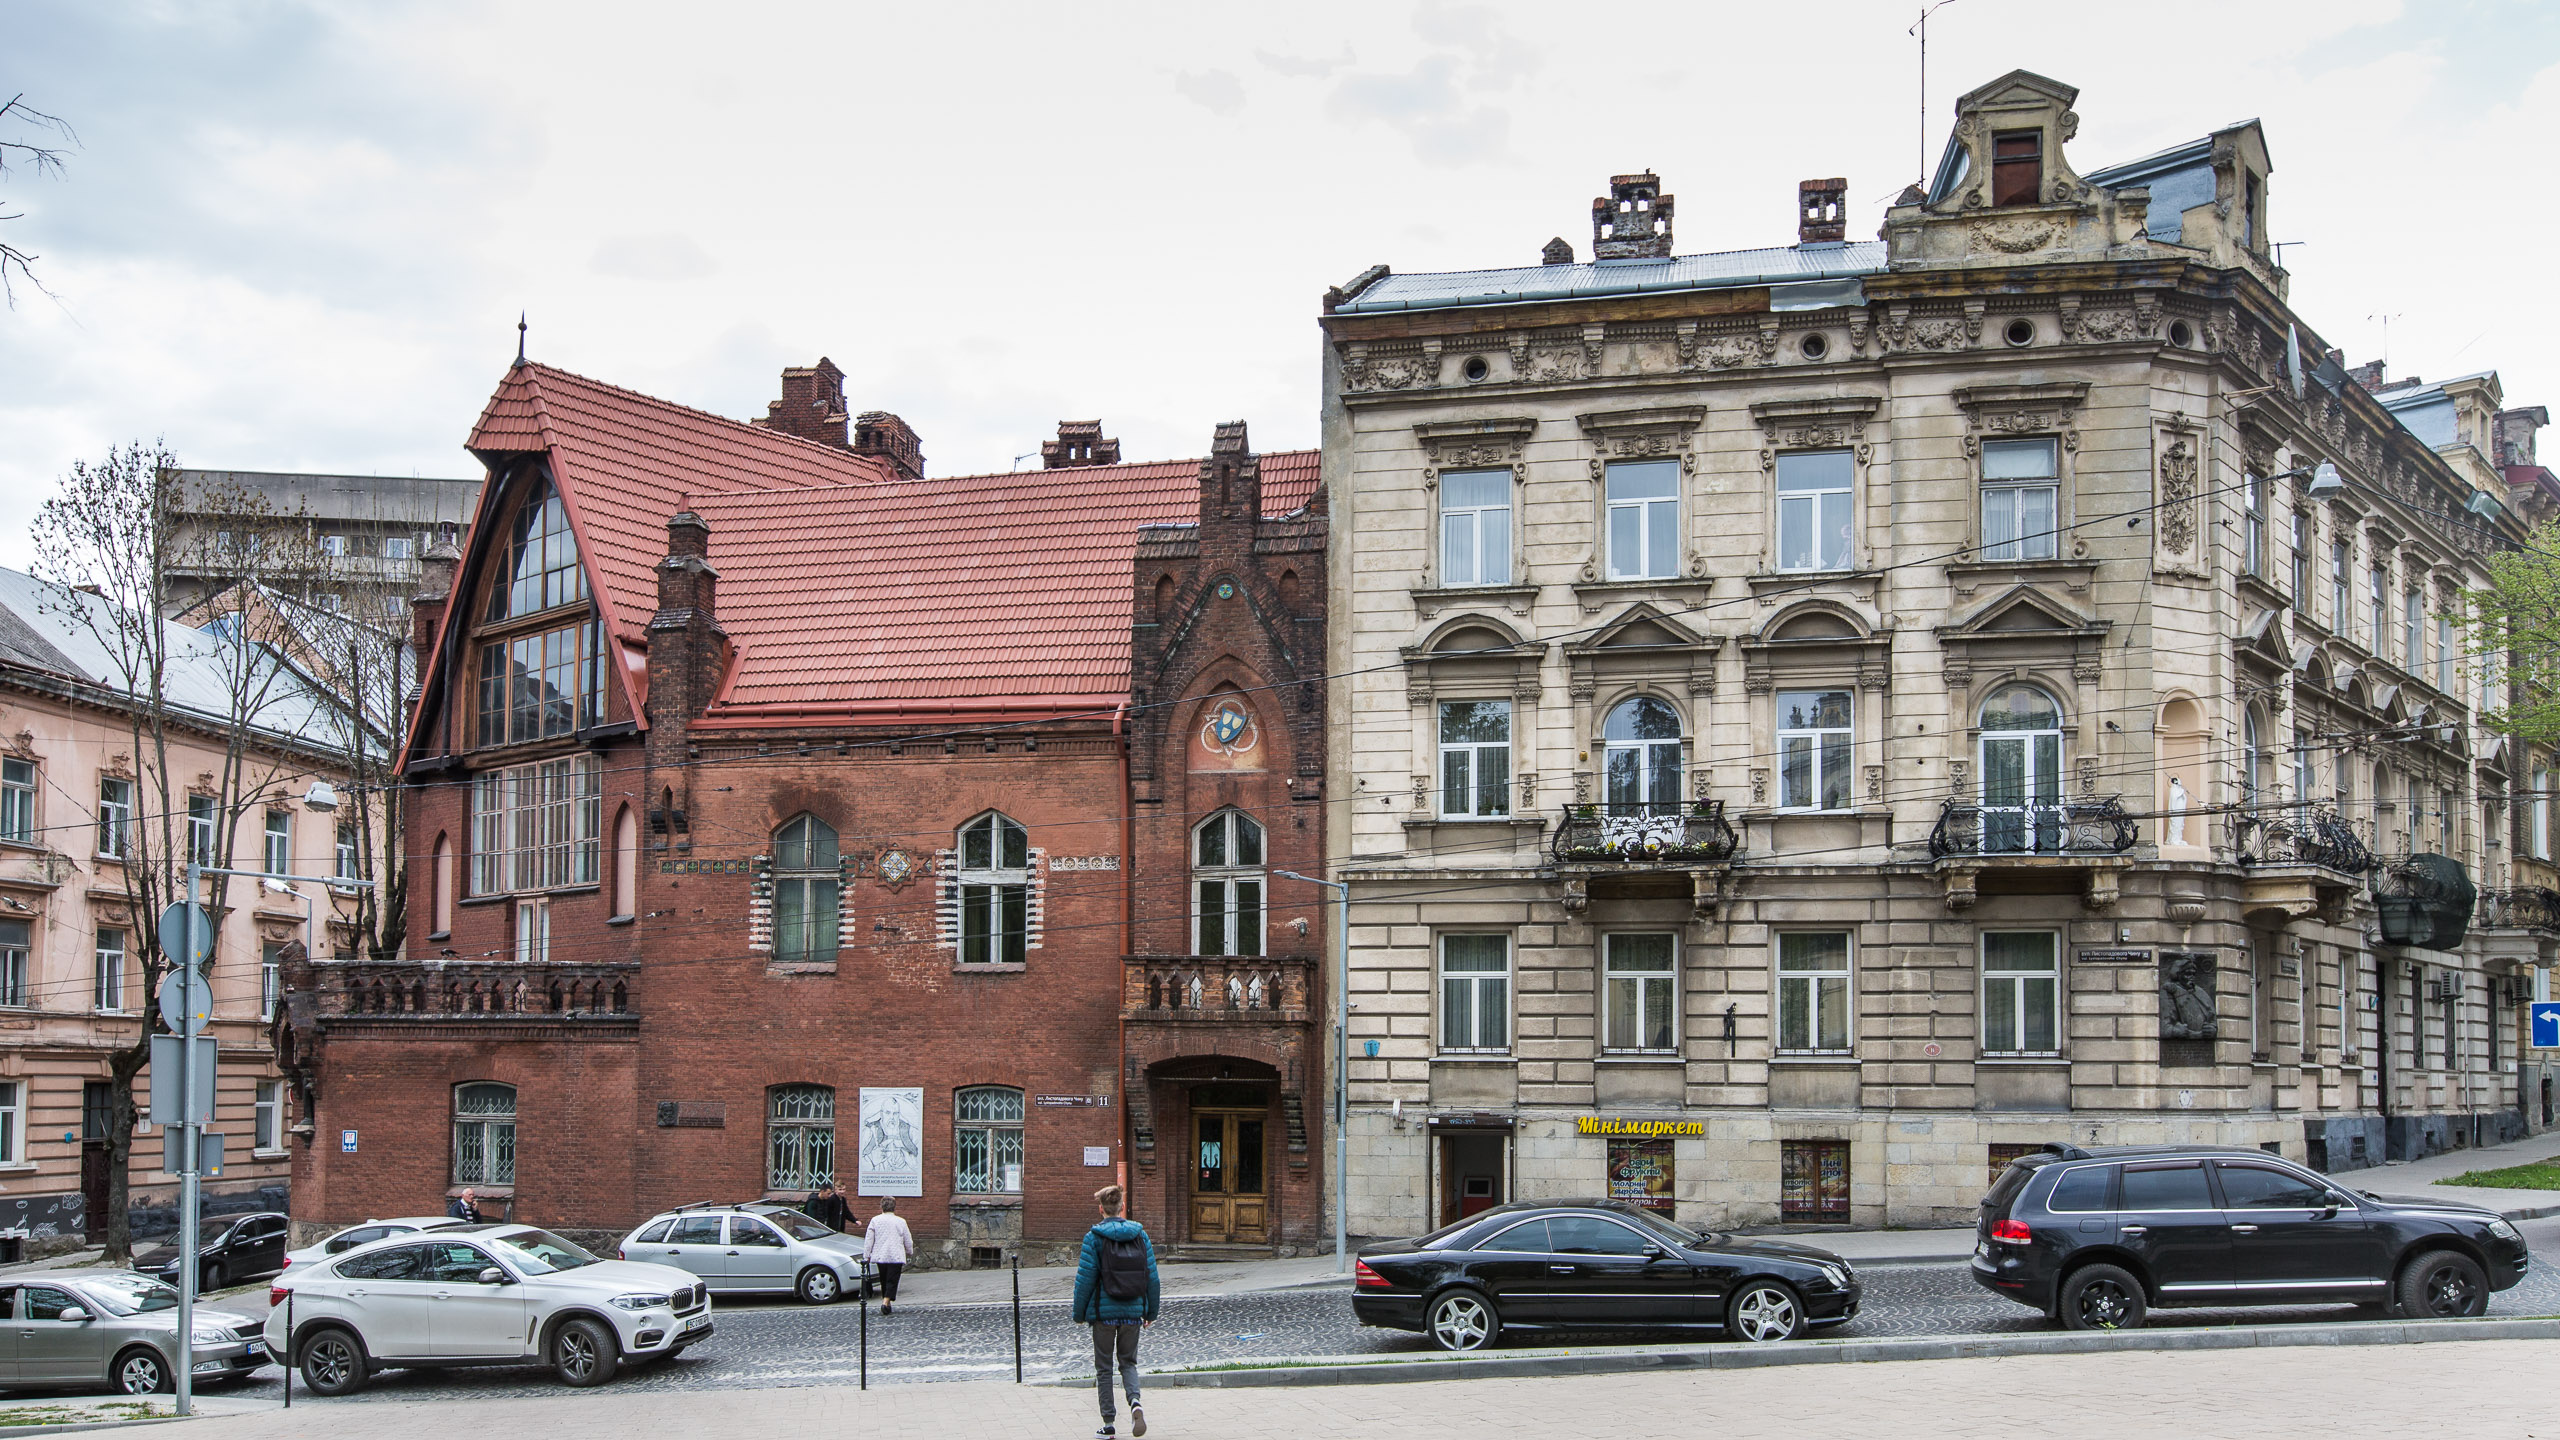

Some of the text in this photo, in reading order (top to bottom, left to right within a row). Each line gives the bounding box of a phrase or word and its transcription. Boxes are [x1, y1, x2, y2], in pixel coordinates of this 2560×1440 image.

[1099, 1096, 1109, 1106] 11
[1577, 1116, 1705, 1138] Мінімаркет
[1820, 1158, 1842, 1167] іцні
[1620, 1167, 1661, 1177] фрукти
[1820, 1168, 1843, 1177] апої
[1612, 1180, 1646, 1188] молочні
